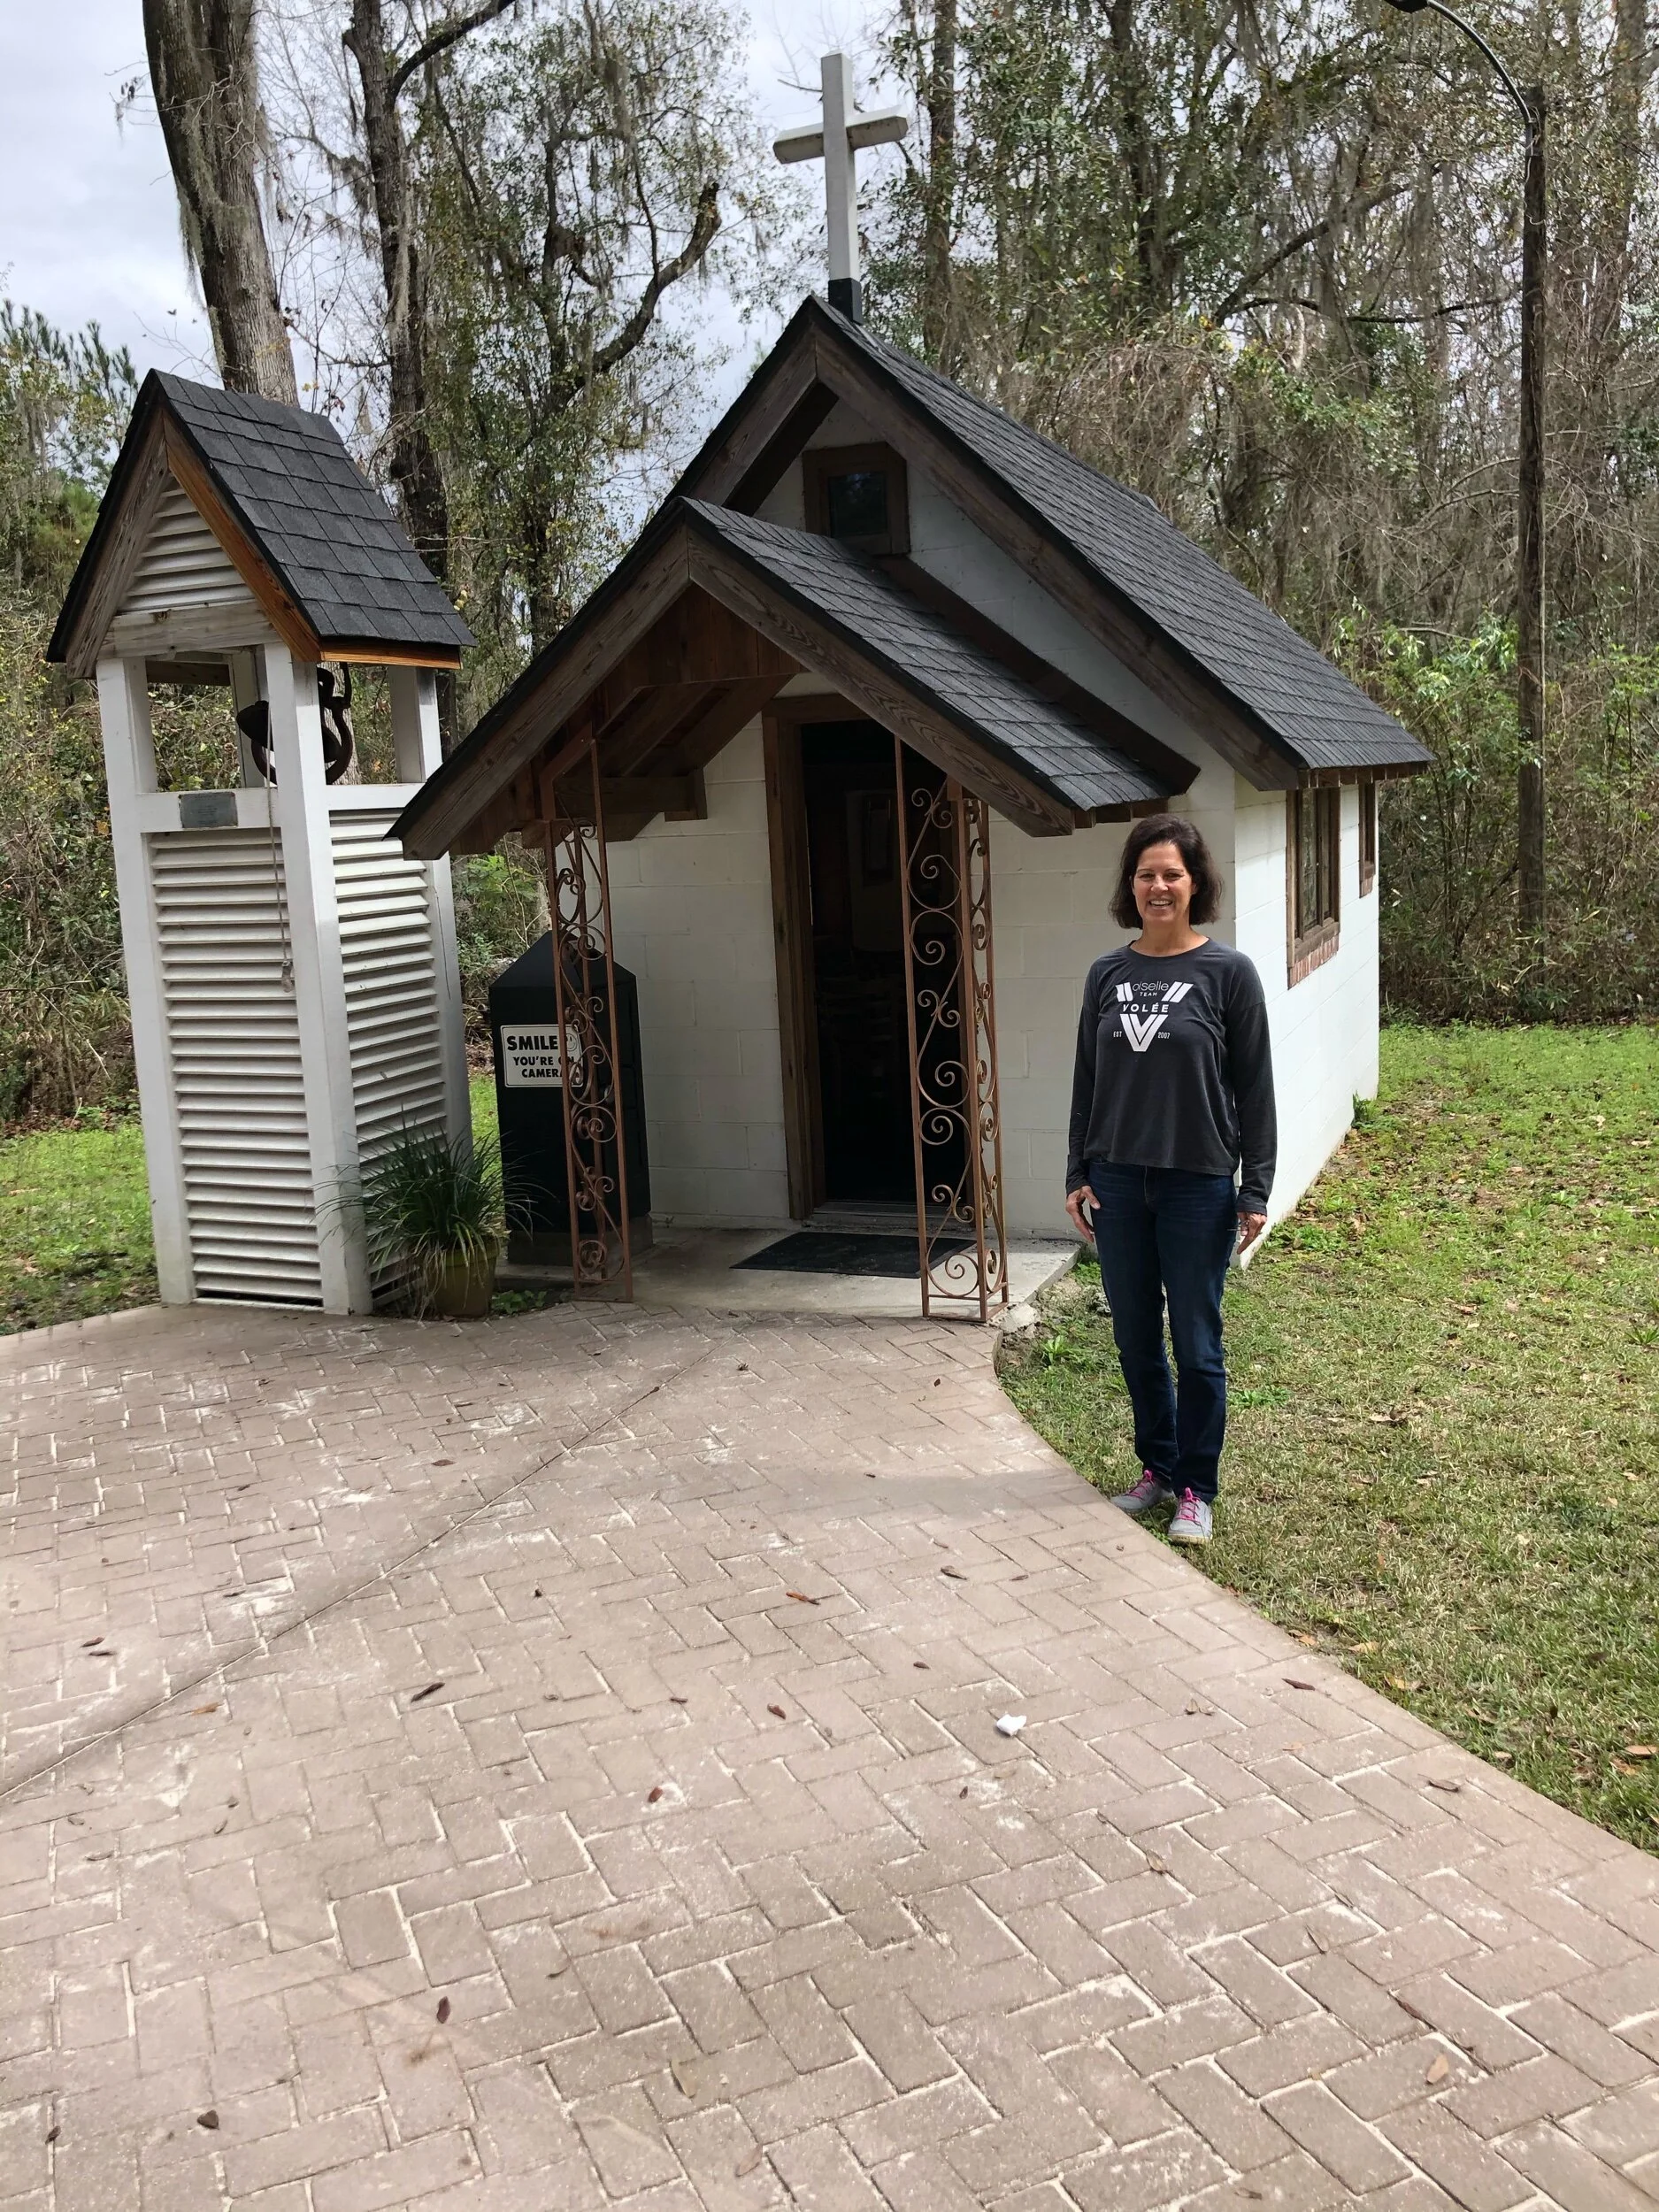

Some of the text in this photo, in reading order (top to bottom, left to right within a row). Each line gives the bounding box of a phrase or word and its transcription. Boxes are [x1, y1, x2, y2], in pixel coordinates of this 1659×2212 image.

[1122, 1002, 1169, 1012] VOLÉE
[506, 1035, 558, 1051] SMILE
[513, 1056, 554, 1066] YOU'RE
